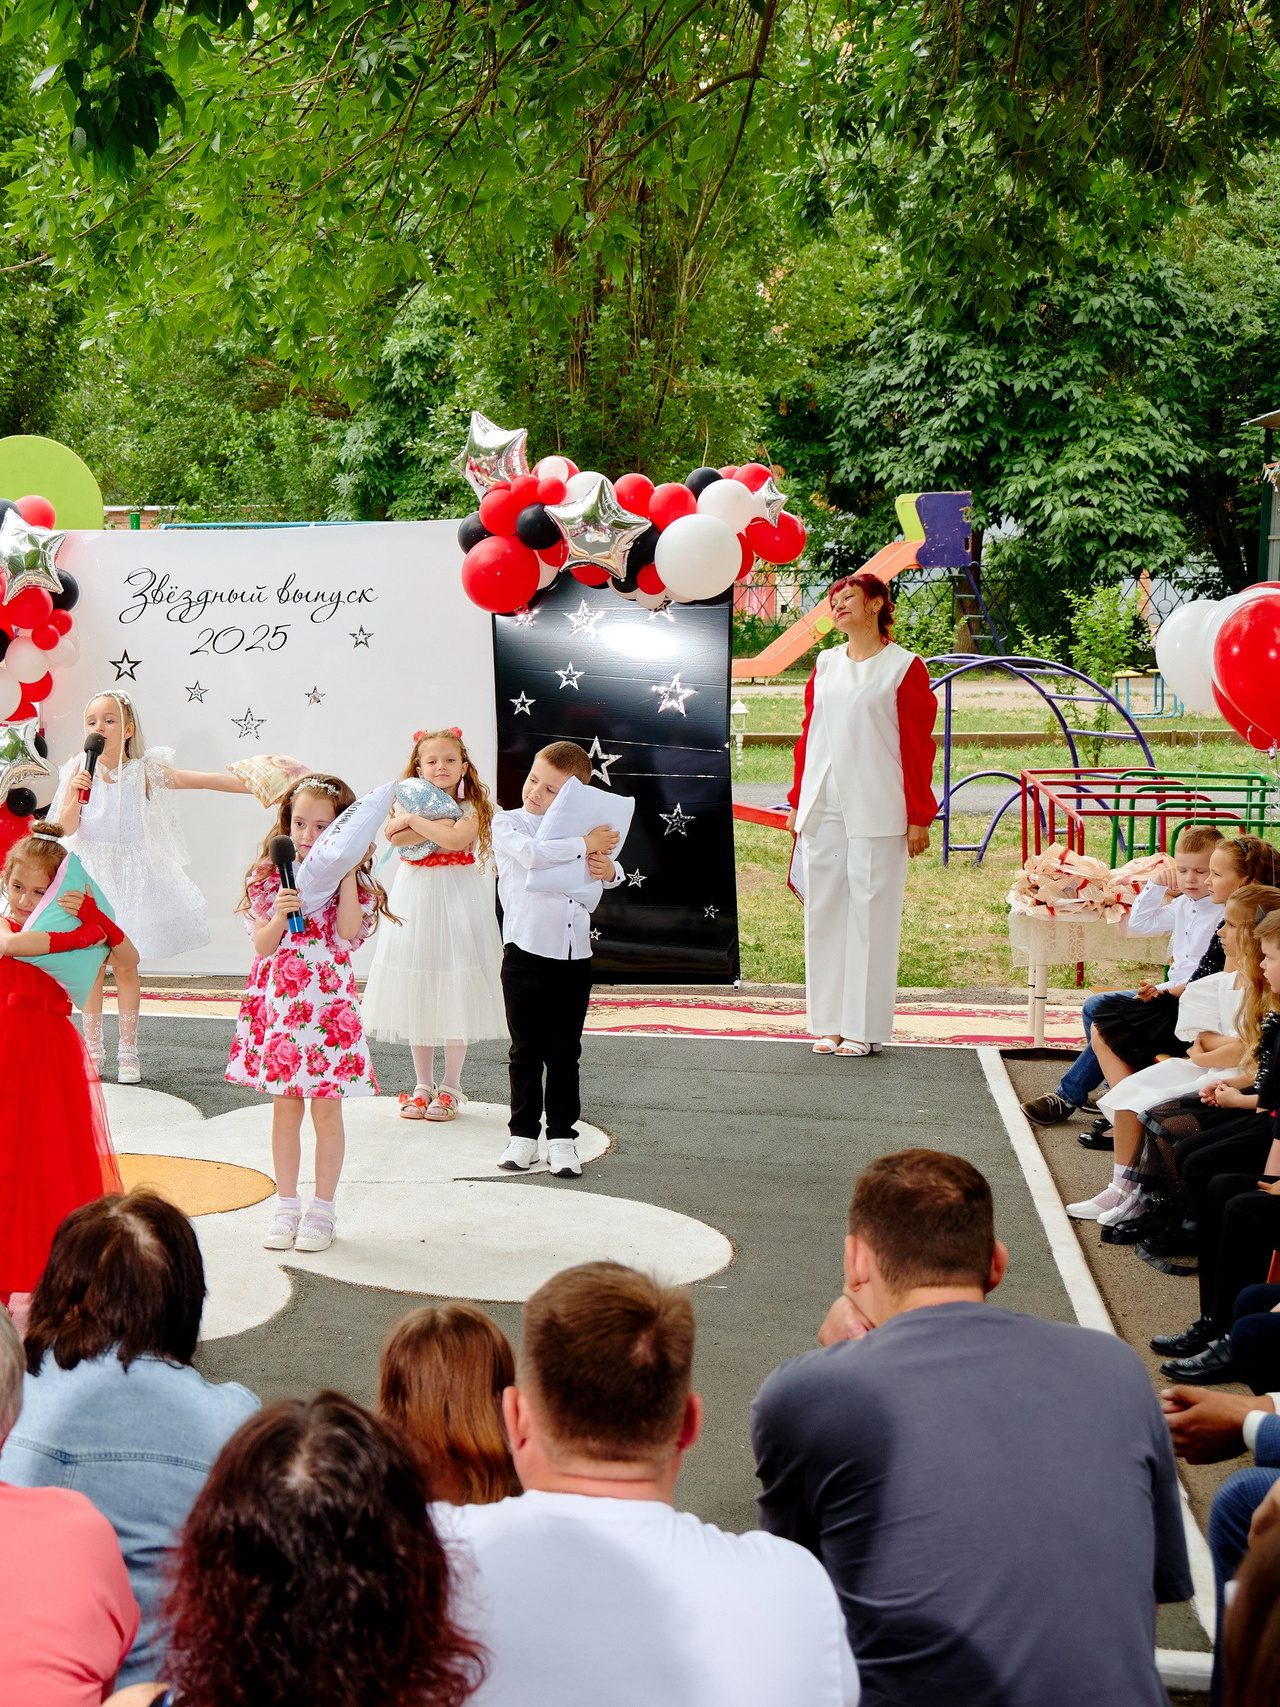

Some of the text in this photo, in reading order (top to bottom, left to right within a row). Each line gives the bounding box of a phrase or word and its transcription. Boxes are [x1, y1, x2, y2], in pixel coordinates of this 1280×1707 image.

[118, 567, 379, 624] Звёздный выпуск
[189, 623, 292, 656] 2025
